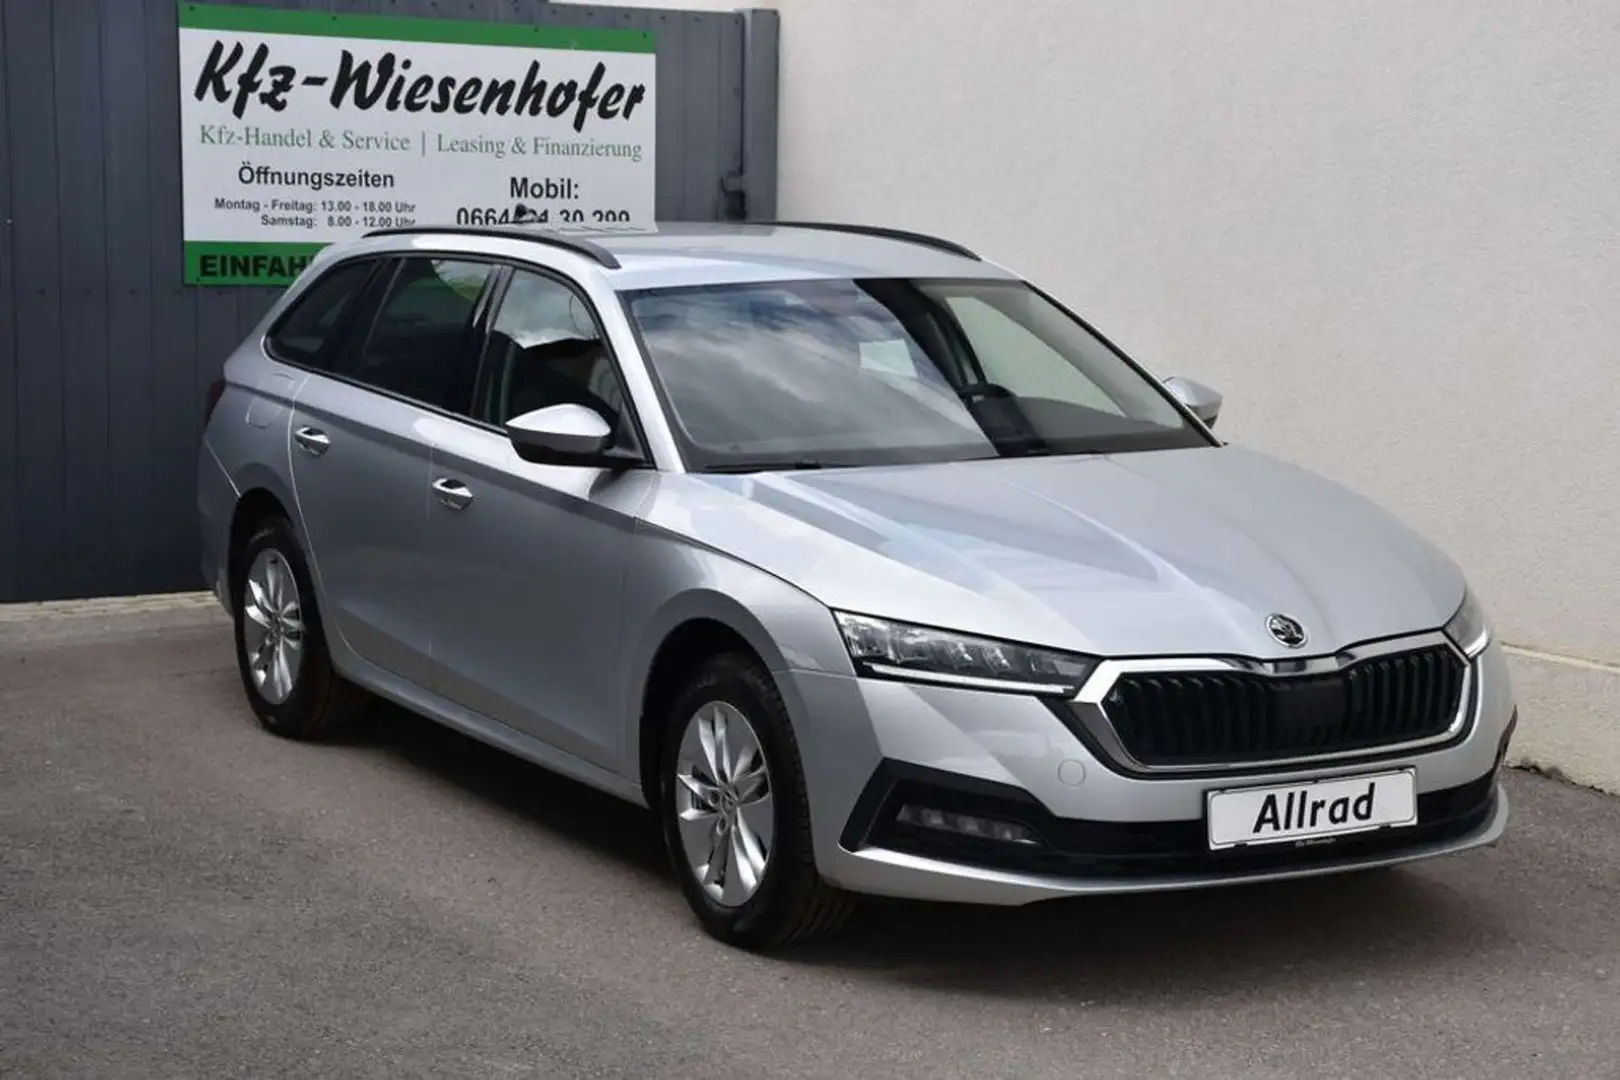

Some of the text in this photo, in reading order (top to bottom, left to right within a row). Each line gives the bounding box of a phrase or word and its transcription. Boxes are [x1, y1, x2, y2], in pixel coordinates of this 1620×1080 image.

[193, 39, 646, 133] Kfz-Wiesenhofer
[200, 125, 312, 148] Kfz-Handel
[318, 129, 340, 150] &
[342, 130, 412, 151] Service
[437, 133, 506, 159] Leasing
[511, 136, 527, 155] &
[533, 137, 643, 162] Finanzierung
[238, 160, 395, 190] Öffnungszeiten
[510, 176, 579, 200] Mobil:
[214, 197, 261, 213] Montag
[271, 199, 317, 214] Freitag:
[321, 200, 351, 213] 13.00
[363, 200, 392, 213] 18.00
[395, 200, 416, 214] Uhr
[456, 207, 509, 225] 0664
[261, 214, 317, 229] Samstag:
[327, 215, 351, 228] 8.00
[363, 216, 392, 228] 12.00
[200, 254, 317, 277] EINFAH
[1252, 782, 1376, 834] Allrad
